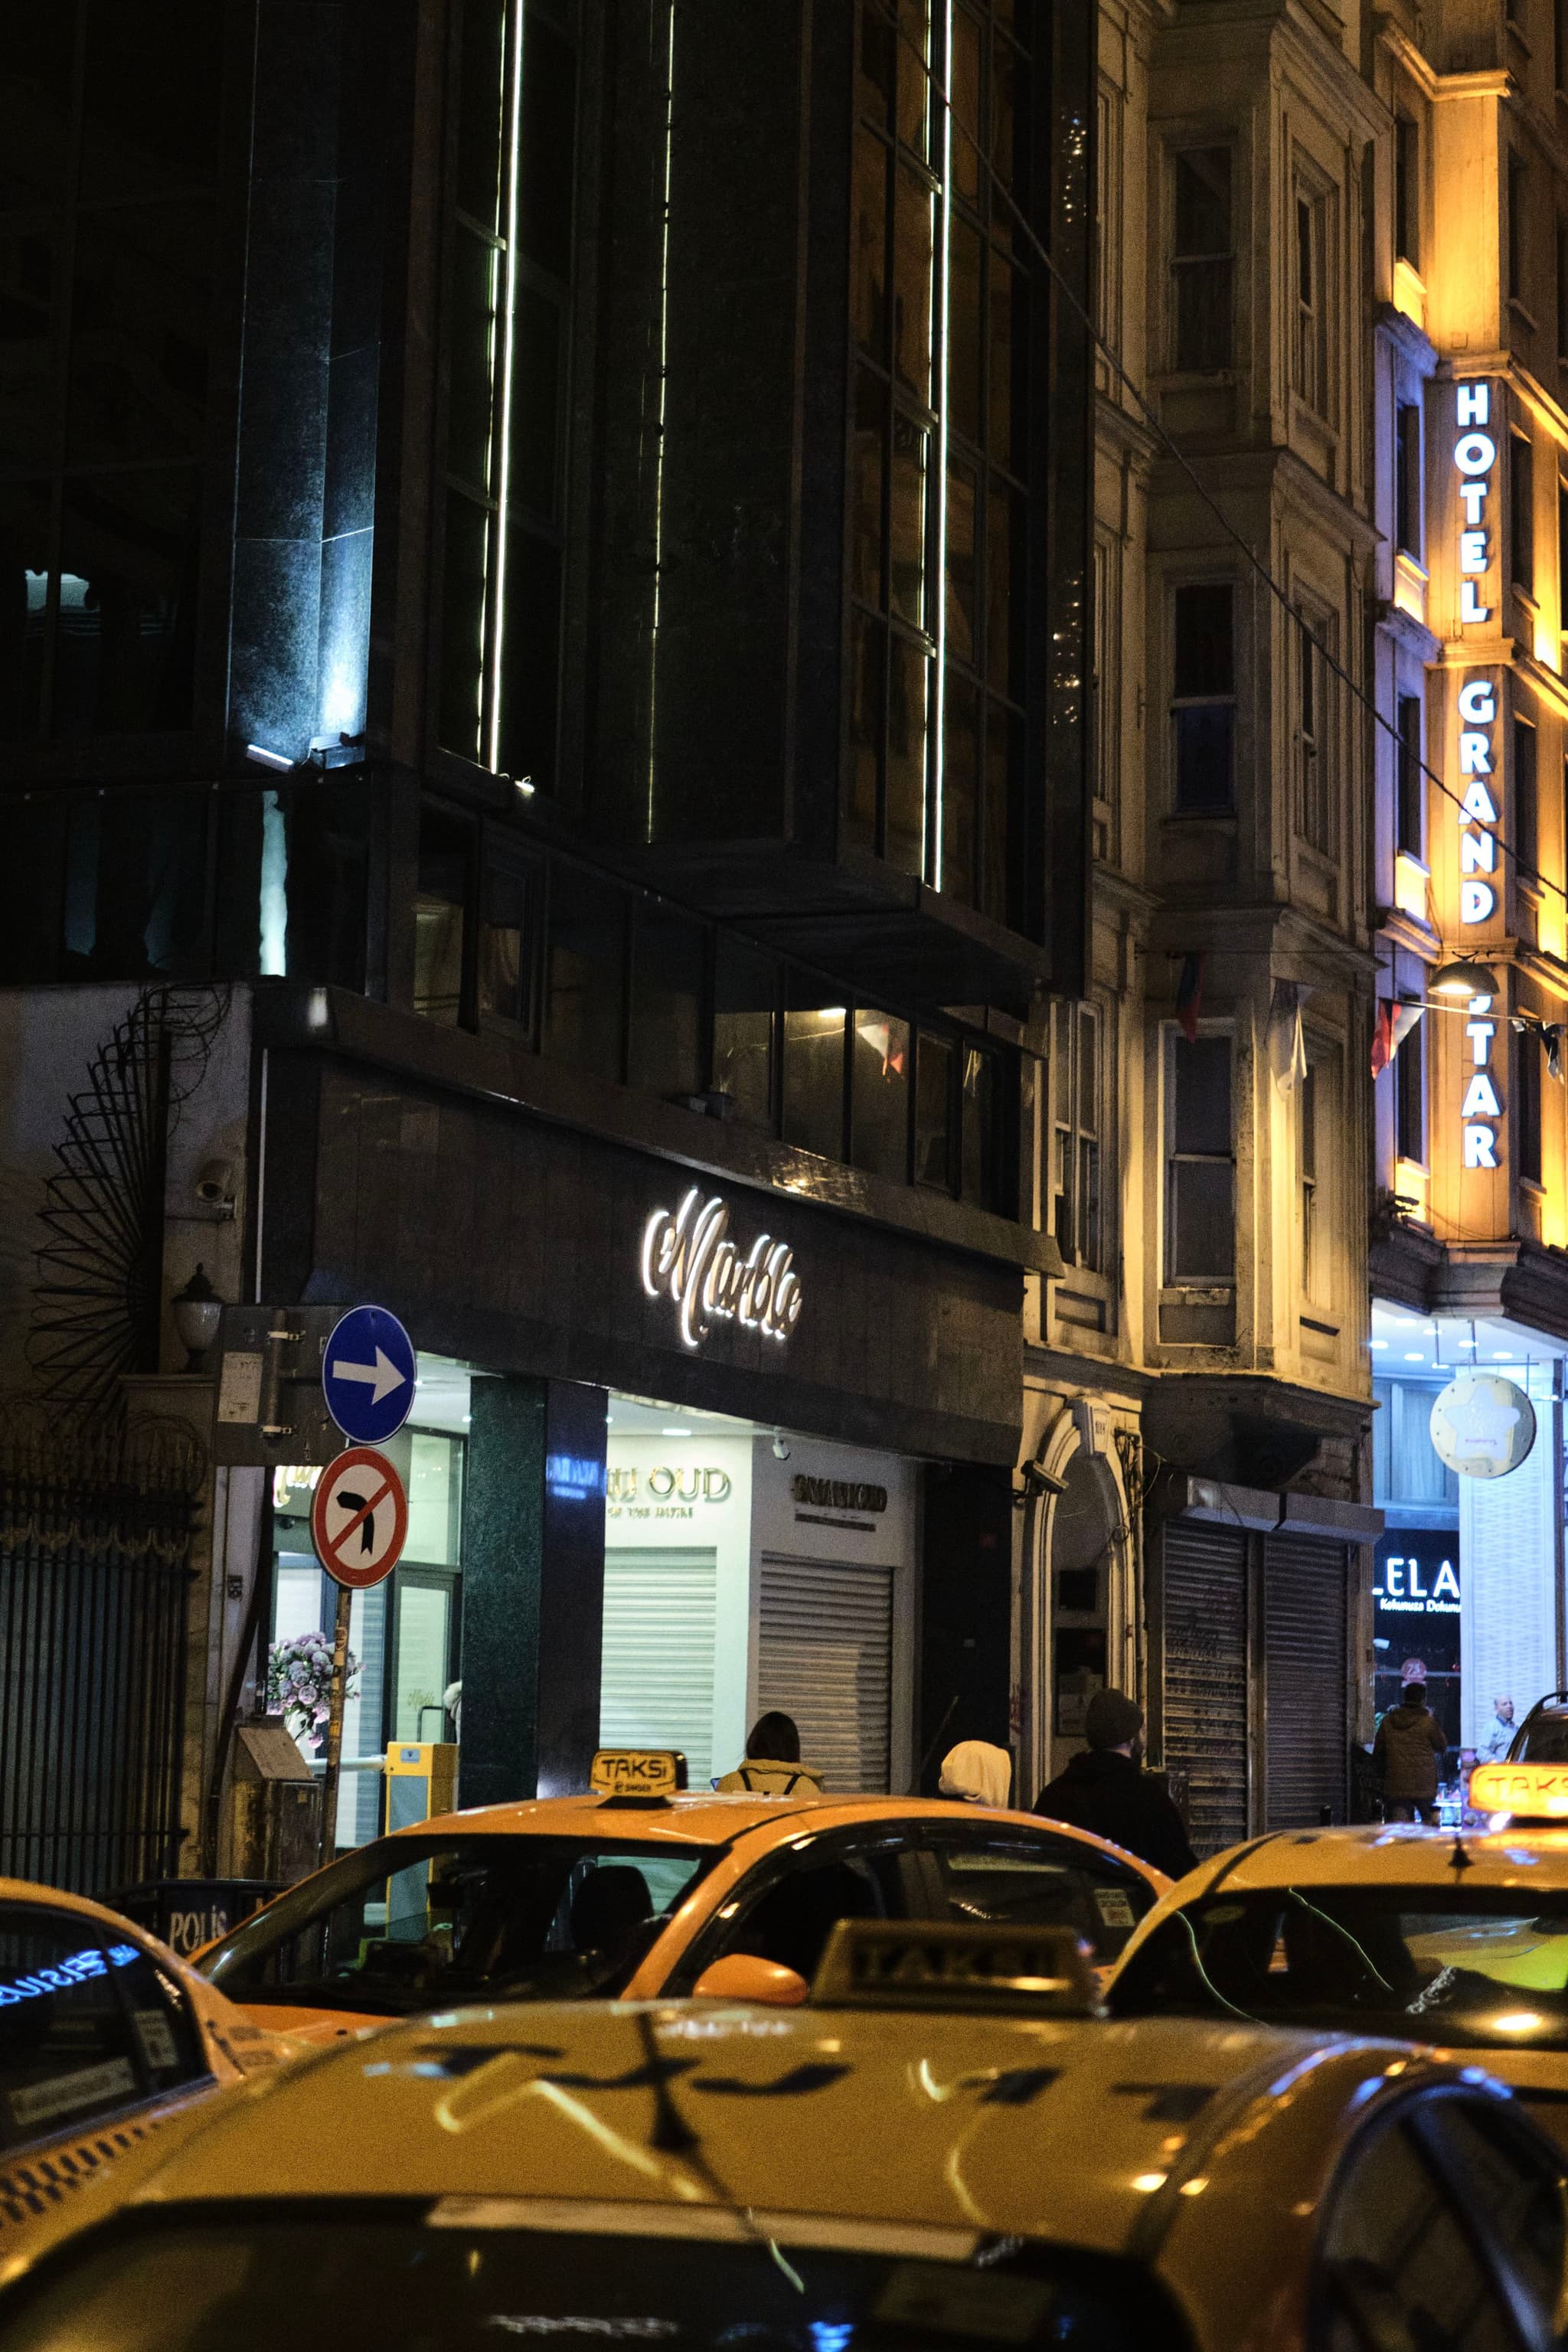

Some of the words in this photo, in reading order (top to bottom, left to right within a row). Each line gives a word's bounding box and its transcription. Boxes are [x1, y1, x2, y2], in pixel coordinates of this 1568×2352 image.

[1455, 384, 1496, 623] HOTEL
[1458, 681, 1497, 923] GRAND
[650, 1467, 730, 1495] OUD
[1371, 1557, 1461, 1598] ELA
